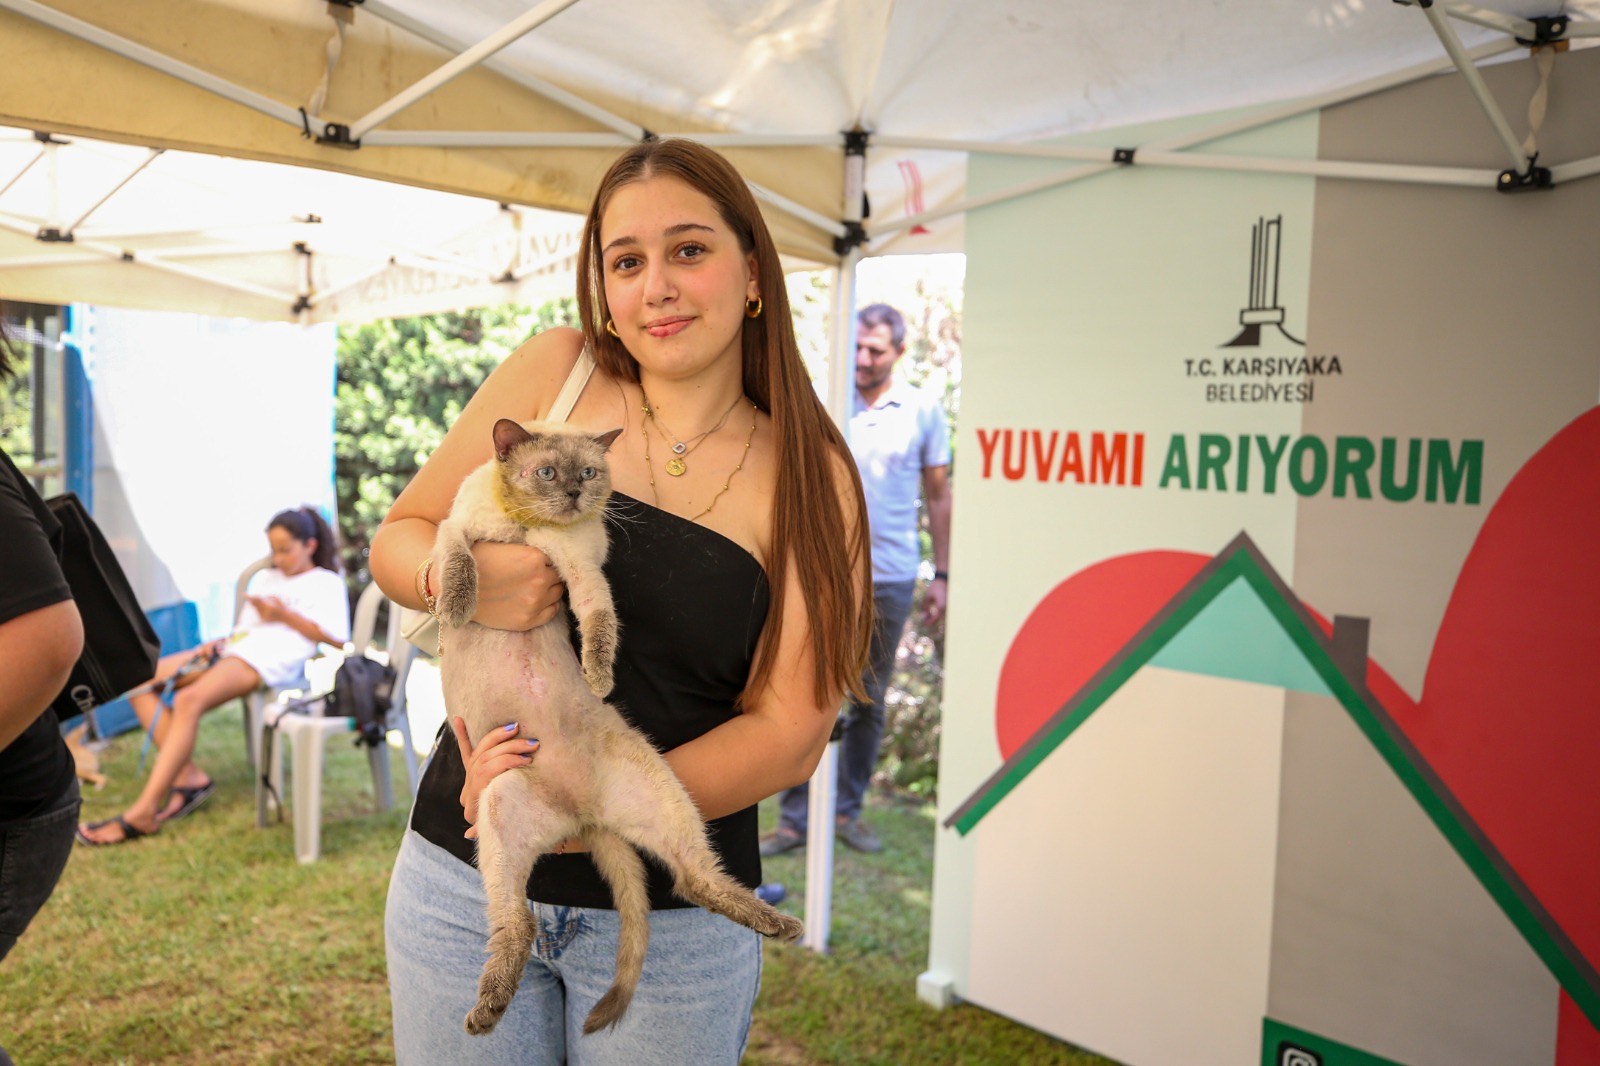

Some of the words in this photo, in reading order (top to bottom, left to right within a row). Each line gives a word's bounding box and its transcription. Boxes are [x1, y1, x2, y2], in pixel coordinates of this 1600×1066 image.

[1185, 359, 1216, 376] T.C.
[1223, 356, 1342, 377] KARŞIYAKA
[1206, 379, 1314, 402] BELEDİYESİ
[977, 429, 1145, 487] YUVAMI
[1159, 434, 1484, 505] ARIYORUM
